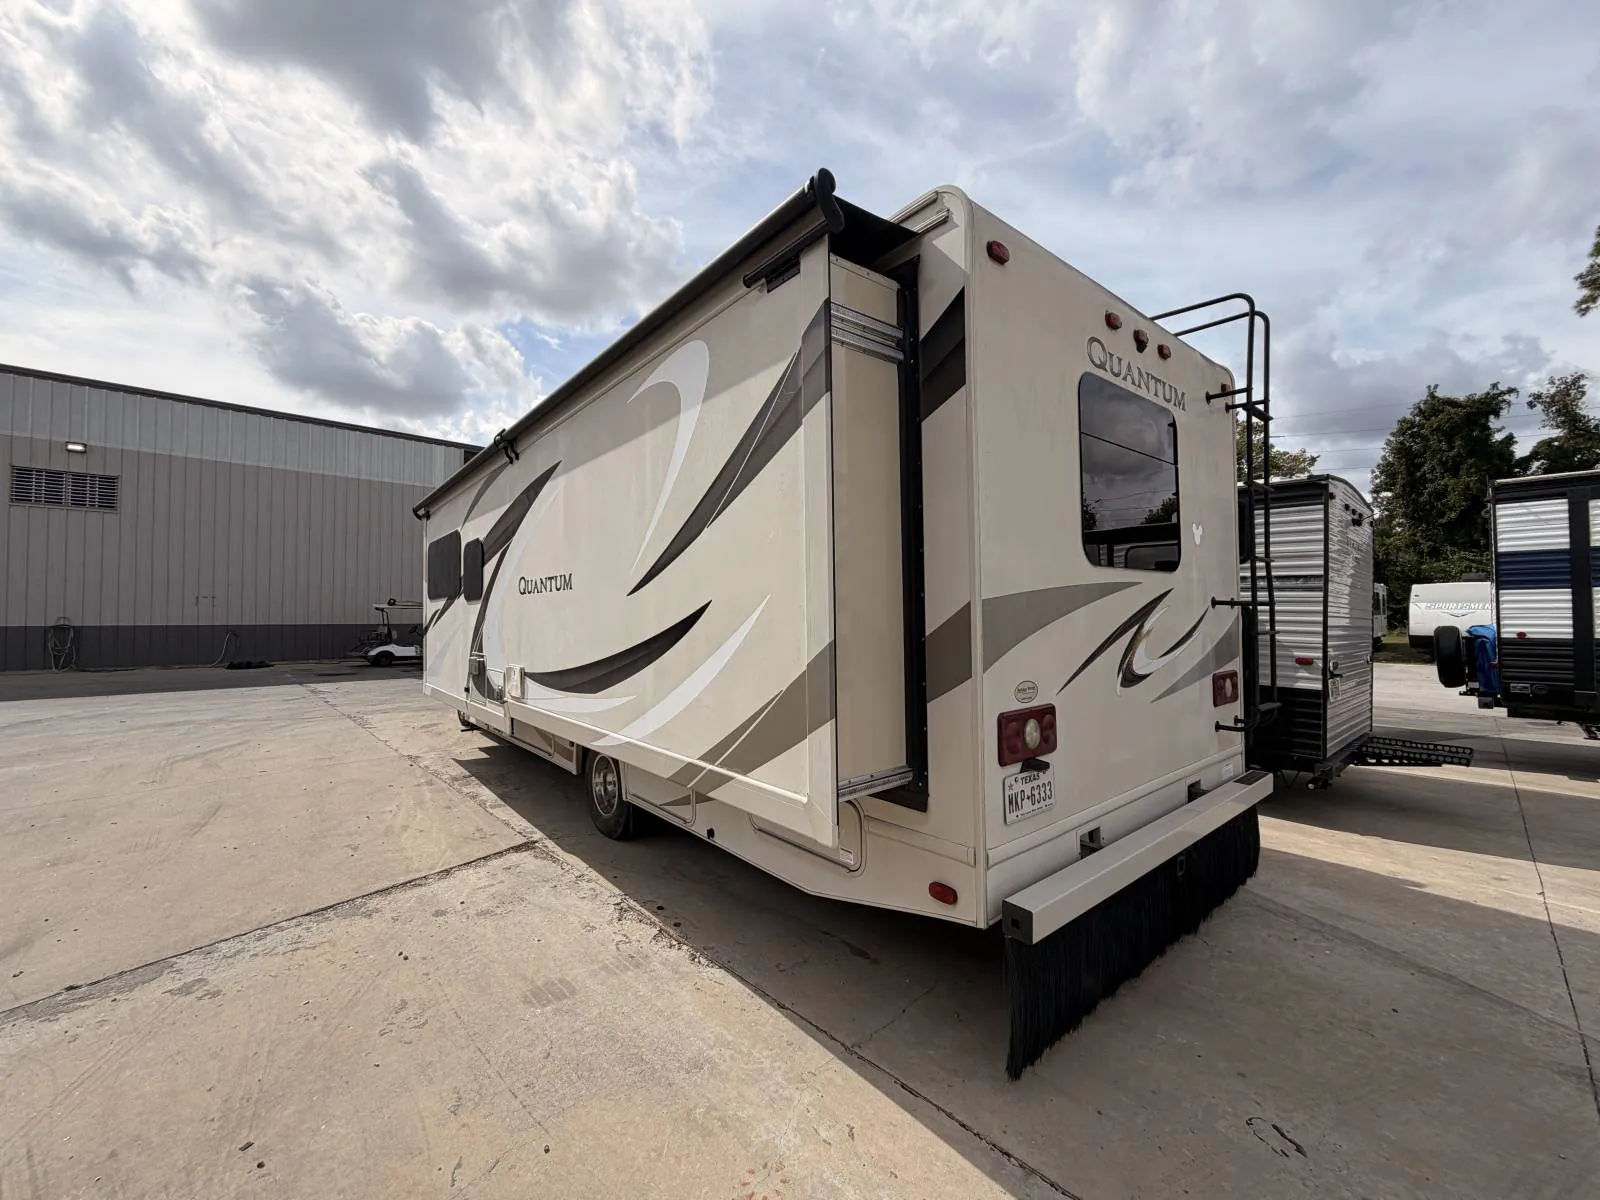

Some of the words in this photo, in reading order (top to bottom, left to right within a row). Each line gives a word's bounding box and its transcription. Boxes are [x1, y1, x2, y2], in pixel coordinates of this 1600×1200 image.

[1087, 336, 1186, 412] QUANTUM
[518, 572, 573, 596] QUANTUM
[1021, 772, 1040, 786] TEXAS
